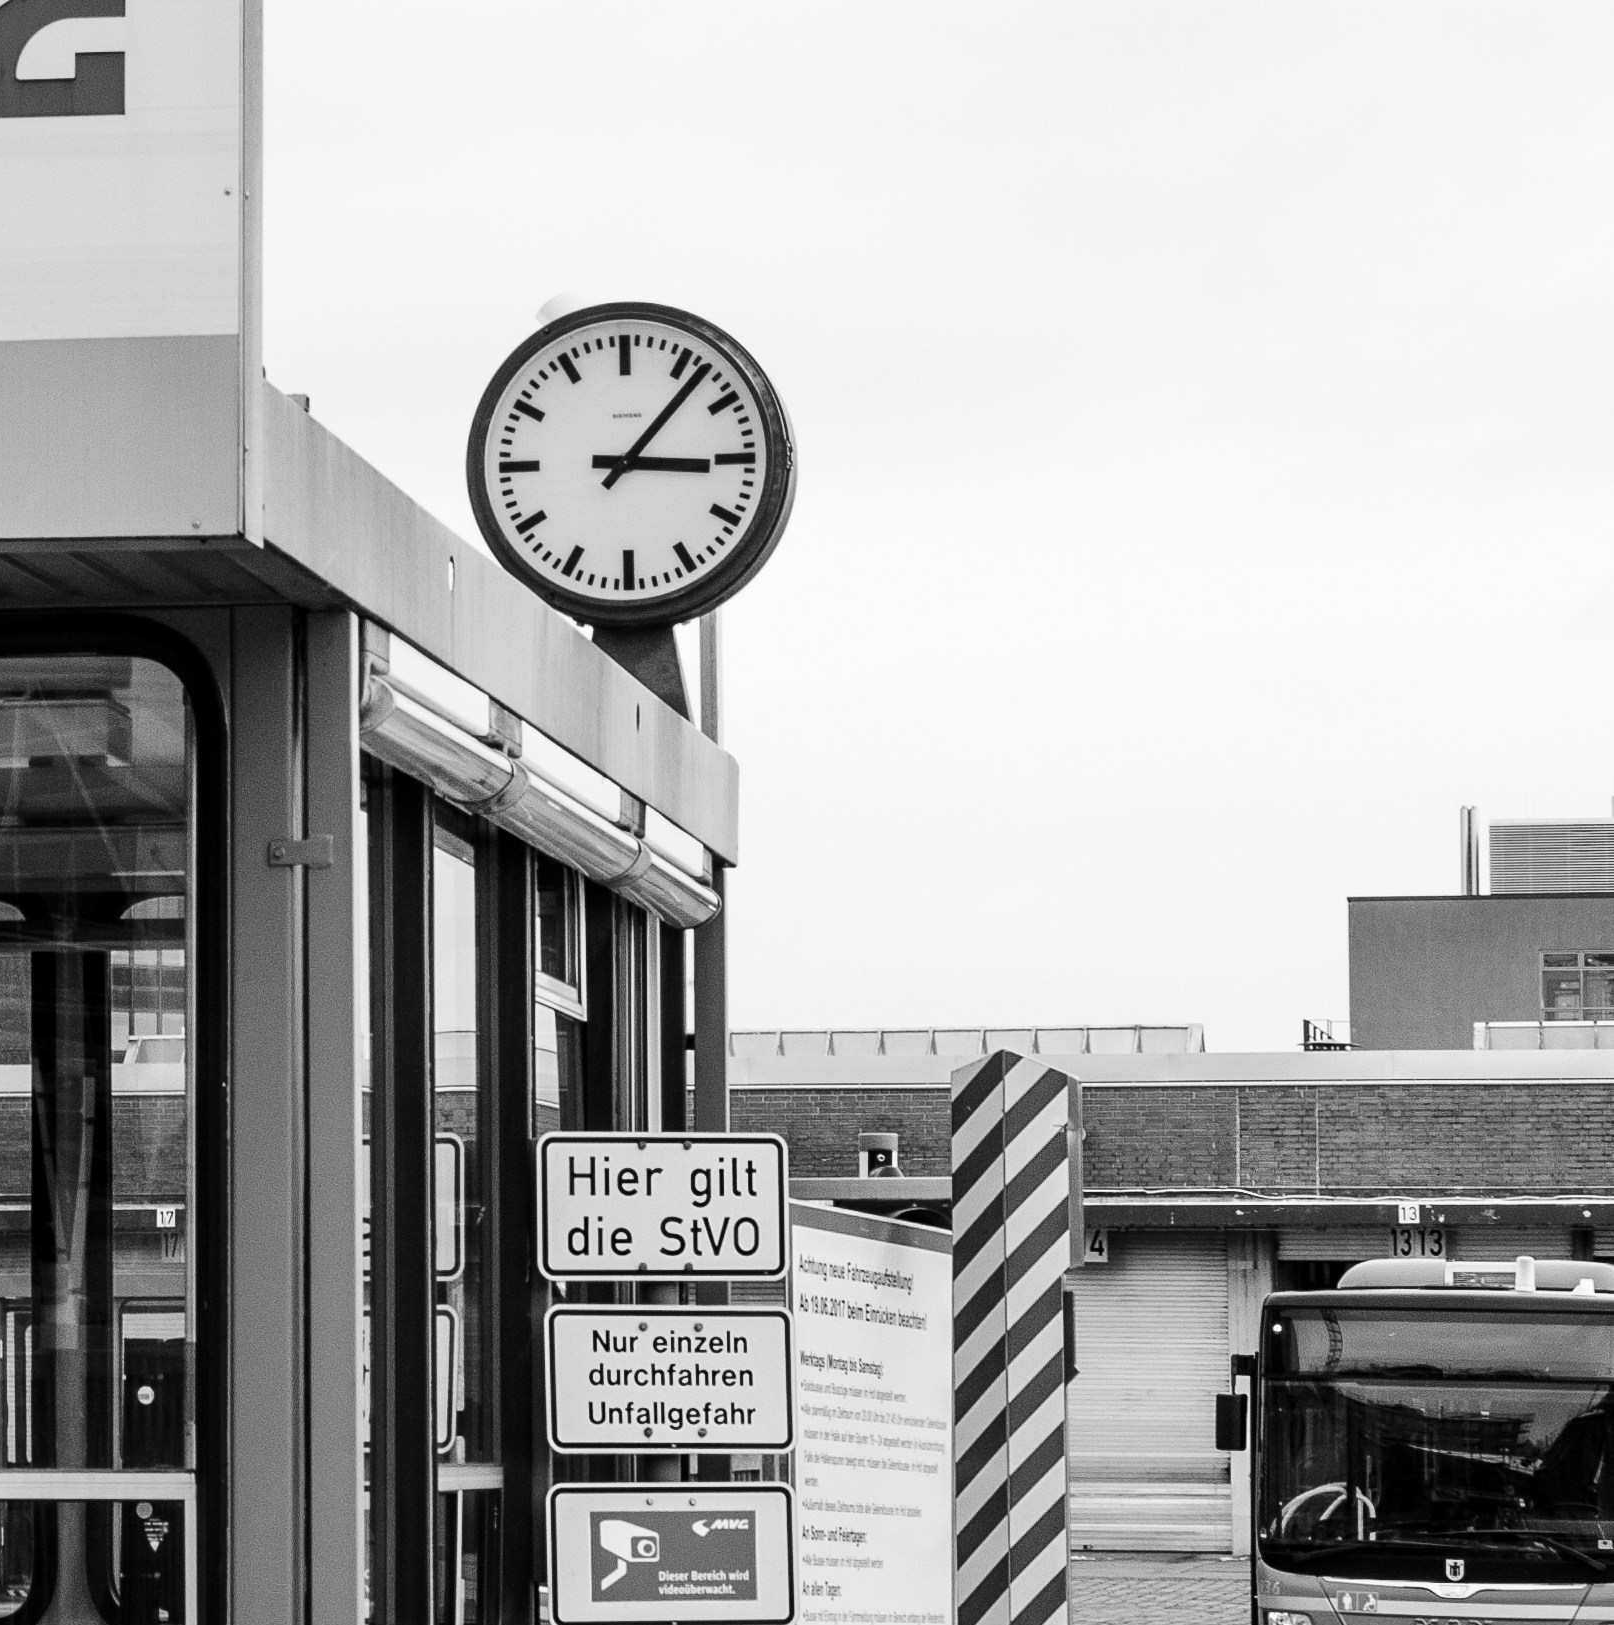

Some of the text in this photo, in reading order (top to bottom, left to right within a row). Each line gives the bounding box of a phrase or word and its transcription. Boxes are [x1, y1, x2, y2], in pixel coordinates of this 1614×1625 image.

[569, 1157, 757, 1207] Hier gilt
[159, 1211, 174, 1225] 17
[1401, 1206, 1417, 1221] 13
[568, 1216, 759, 1256] die StVO
[1391, 1228, 1443, 1257] 13 13
[799, 1254, 827, 1281] Achtung
[829, 1264, 845, 1279] neue
[799, 1293, 809, 1312] Ab
[847, 1300, 864, 1321] beim
[593, 1330, 748, 1353] Nur einzeln
[589, 1363, 753, 1386] durchfahren
[589, 1402, 755, 1430] Unfallgefahr
[710, 1519, 749, 1530] MVG
[658, 1570, 750, 1582] Dieser Bereich wird
[658, 1583, 736, 1595] videoüberwacht.
